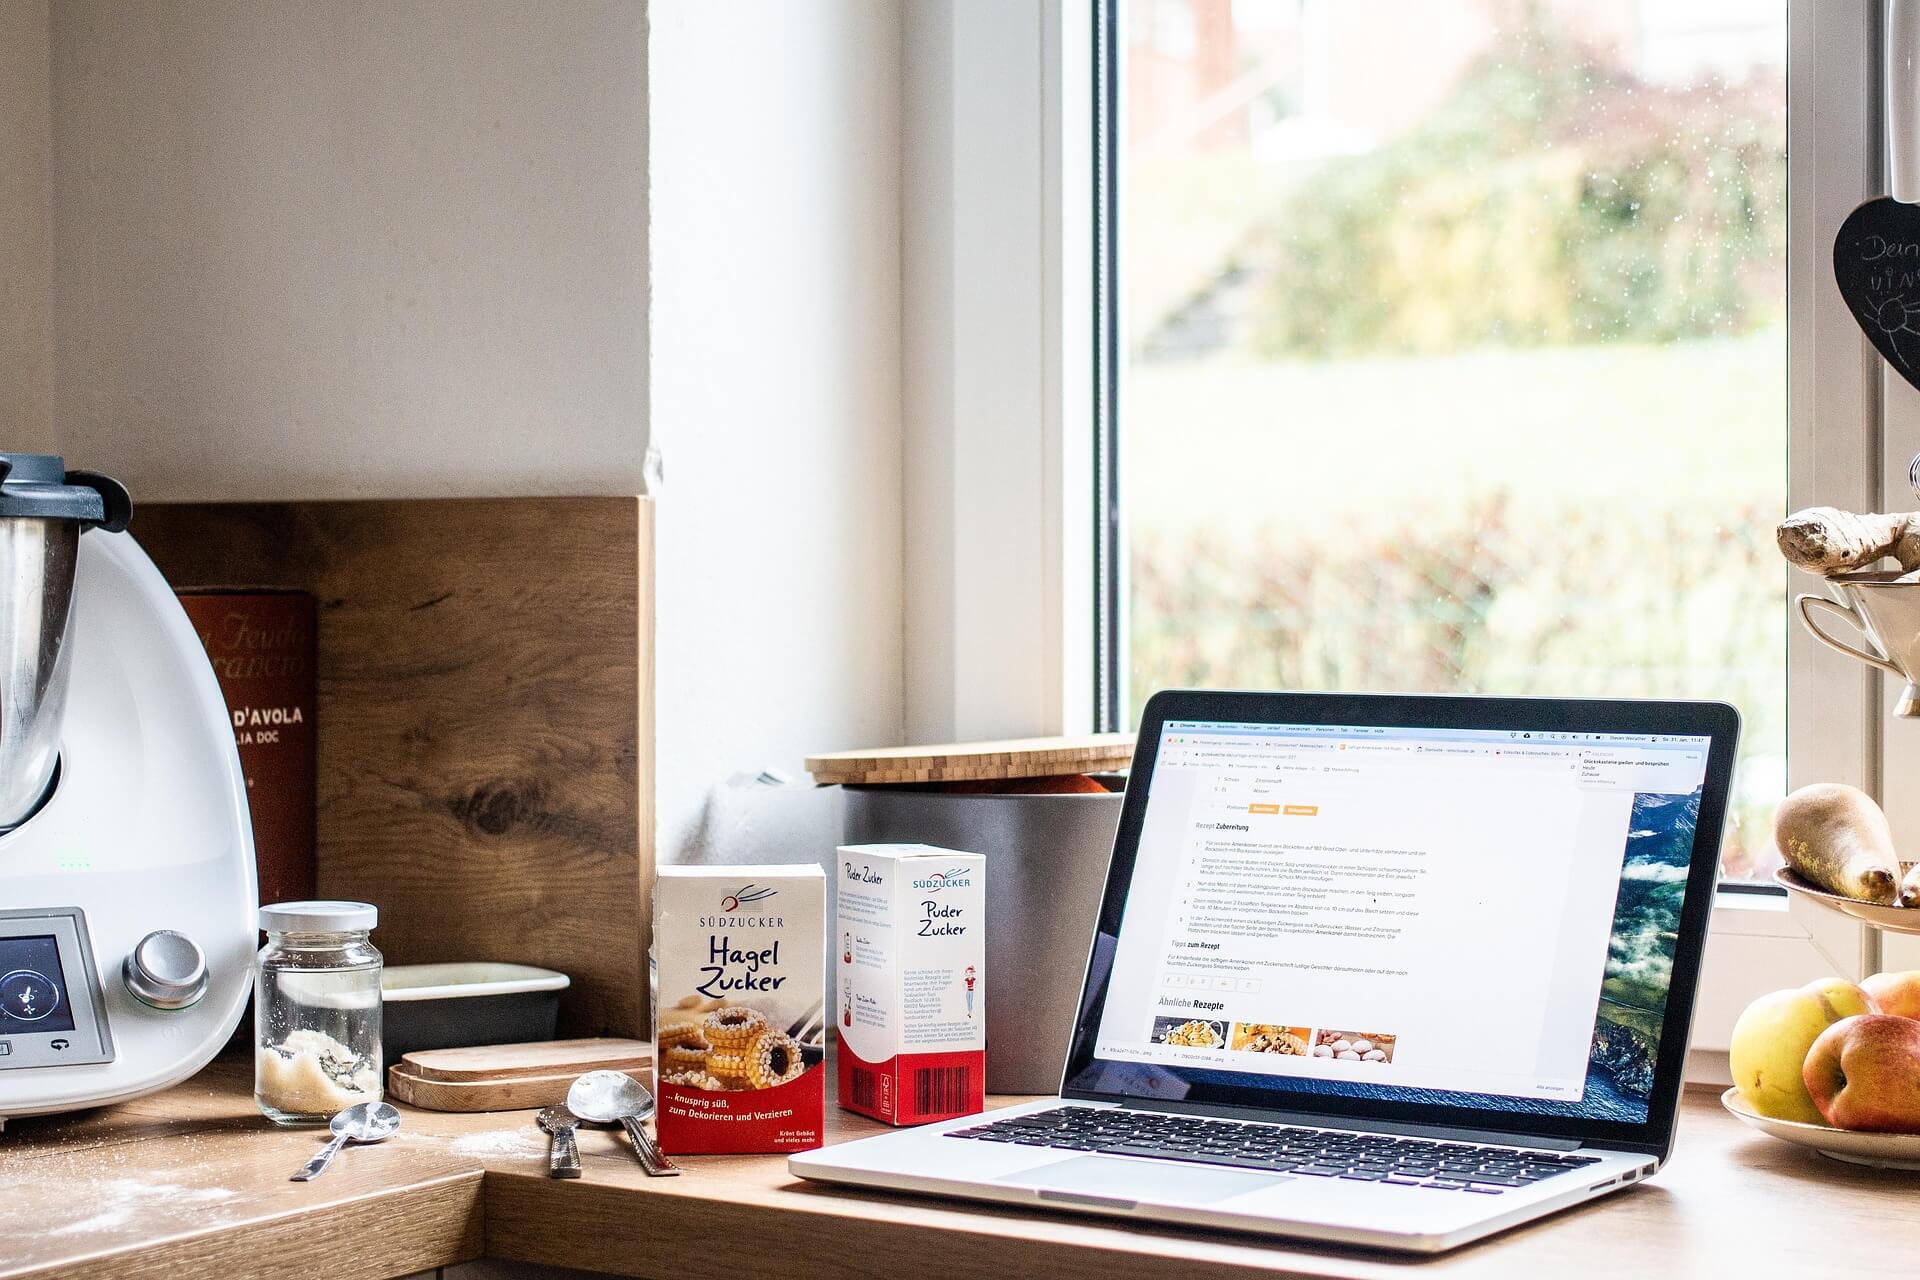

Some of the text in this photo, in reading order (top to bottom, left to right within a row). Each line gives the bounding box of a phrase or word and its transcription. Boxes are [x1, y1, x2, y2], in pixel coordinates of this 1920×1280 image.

[234, 706, 303, 727] D'AVOLA
[238, 730, 279, 745] IA DOC
[1196, 822, 1250, 832] Rezept Zubereitung
[845, 862, 882, 885] Puder Zucker
[913, 878, 970, 889] SÜDZUCKER
[921, 900, 963, 918] Puder
[700, 916, 784, 928] SÜDZUCKER
[917, 919, 966, 937] Zucker
[709, 935, 779, 972] Hagel
[1172, 940, 1187, 948] Tipps
[1200, 942, 1220, 950] Rezept
[696, 966, 787, 999] Zucker
[1158, 995, 1224, 1012] Ähnliche Rezepte
[674, 1092, 709, 1109] knusprig
[712, 1100, 730, 1109] süß,
[669, 1106, 793, 1121] zum Dekorieren und Verzieren
